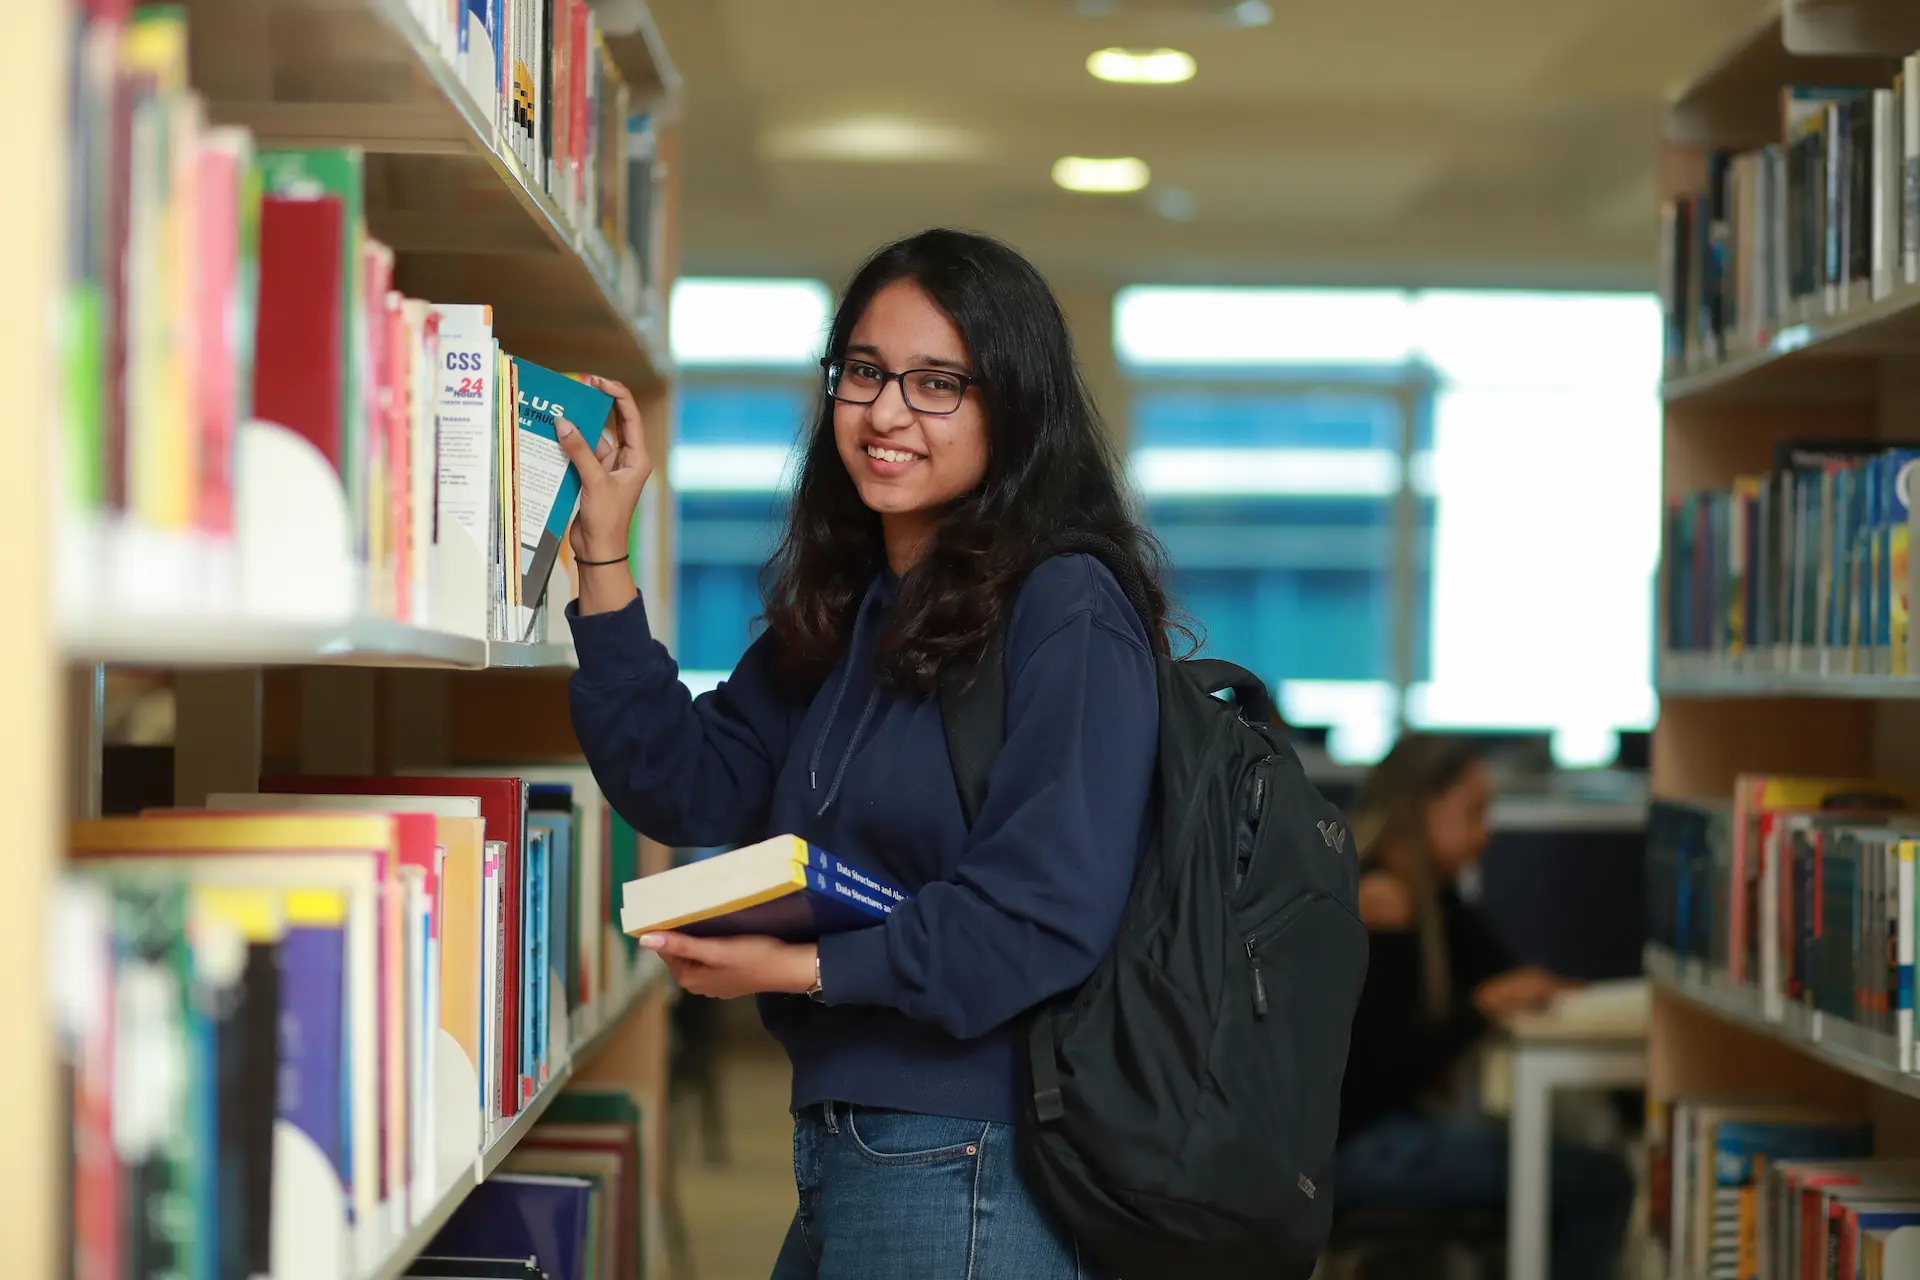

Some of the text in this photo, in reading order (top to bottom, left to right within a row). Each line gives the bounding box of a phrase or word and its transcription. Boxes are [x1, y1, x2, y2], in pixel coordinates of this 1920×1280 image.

[446, 352, 482, 371] CSS
[459, 377, 484, 394] 24
[518, 391, 565, 417] LUS
[518, 417, 533, 427] ALE
[523, 407, 555, 426] STRUC
[836, 862, 851, 877] Data
[852, 870, 881, 891] Structures
[881, 886, 892, 897] and
[835, 882, 894, 914] Data Structures an
